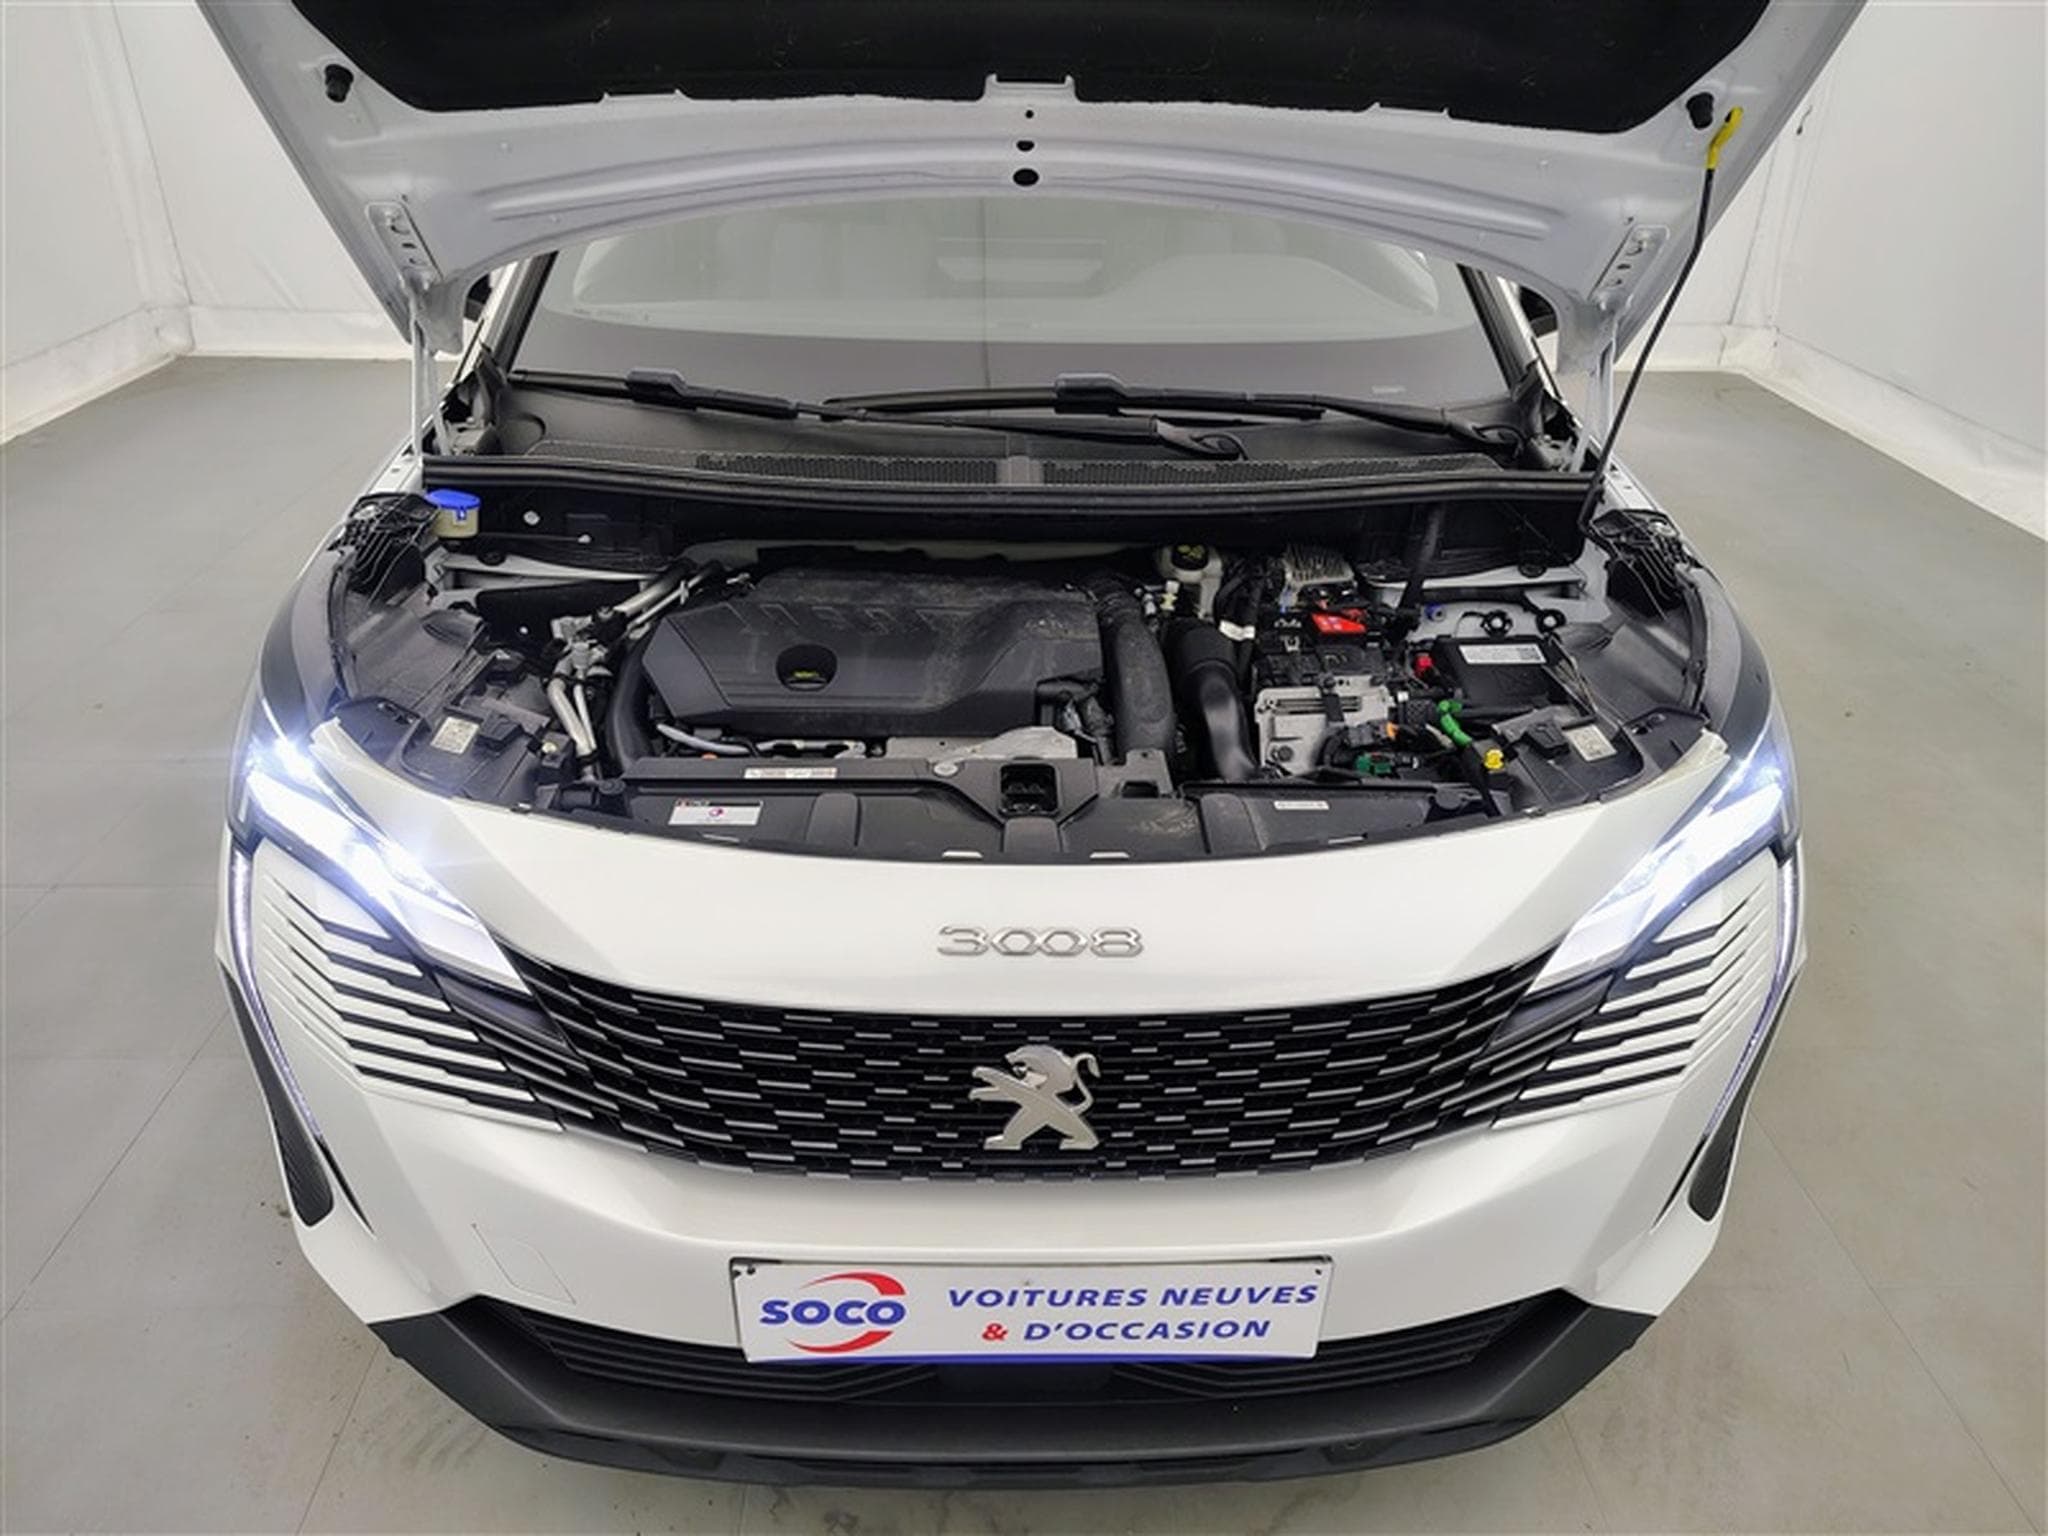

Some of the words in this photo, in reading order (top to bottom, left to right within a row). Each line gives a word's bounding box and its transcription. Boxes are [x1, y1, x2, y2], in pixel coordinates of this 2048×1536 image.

[937, 926, 1144, 957] 3008
[949, 1289, 1147, 1307] VOITURES
[1160, 1285, 1318, 1306] NEUVES
[760, 1300, 906, 1325] SOCO
[982, 1322, 1008, 1341] &
[1024, 1320, 1270, 1341] D'OCCASION
